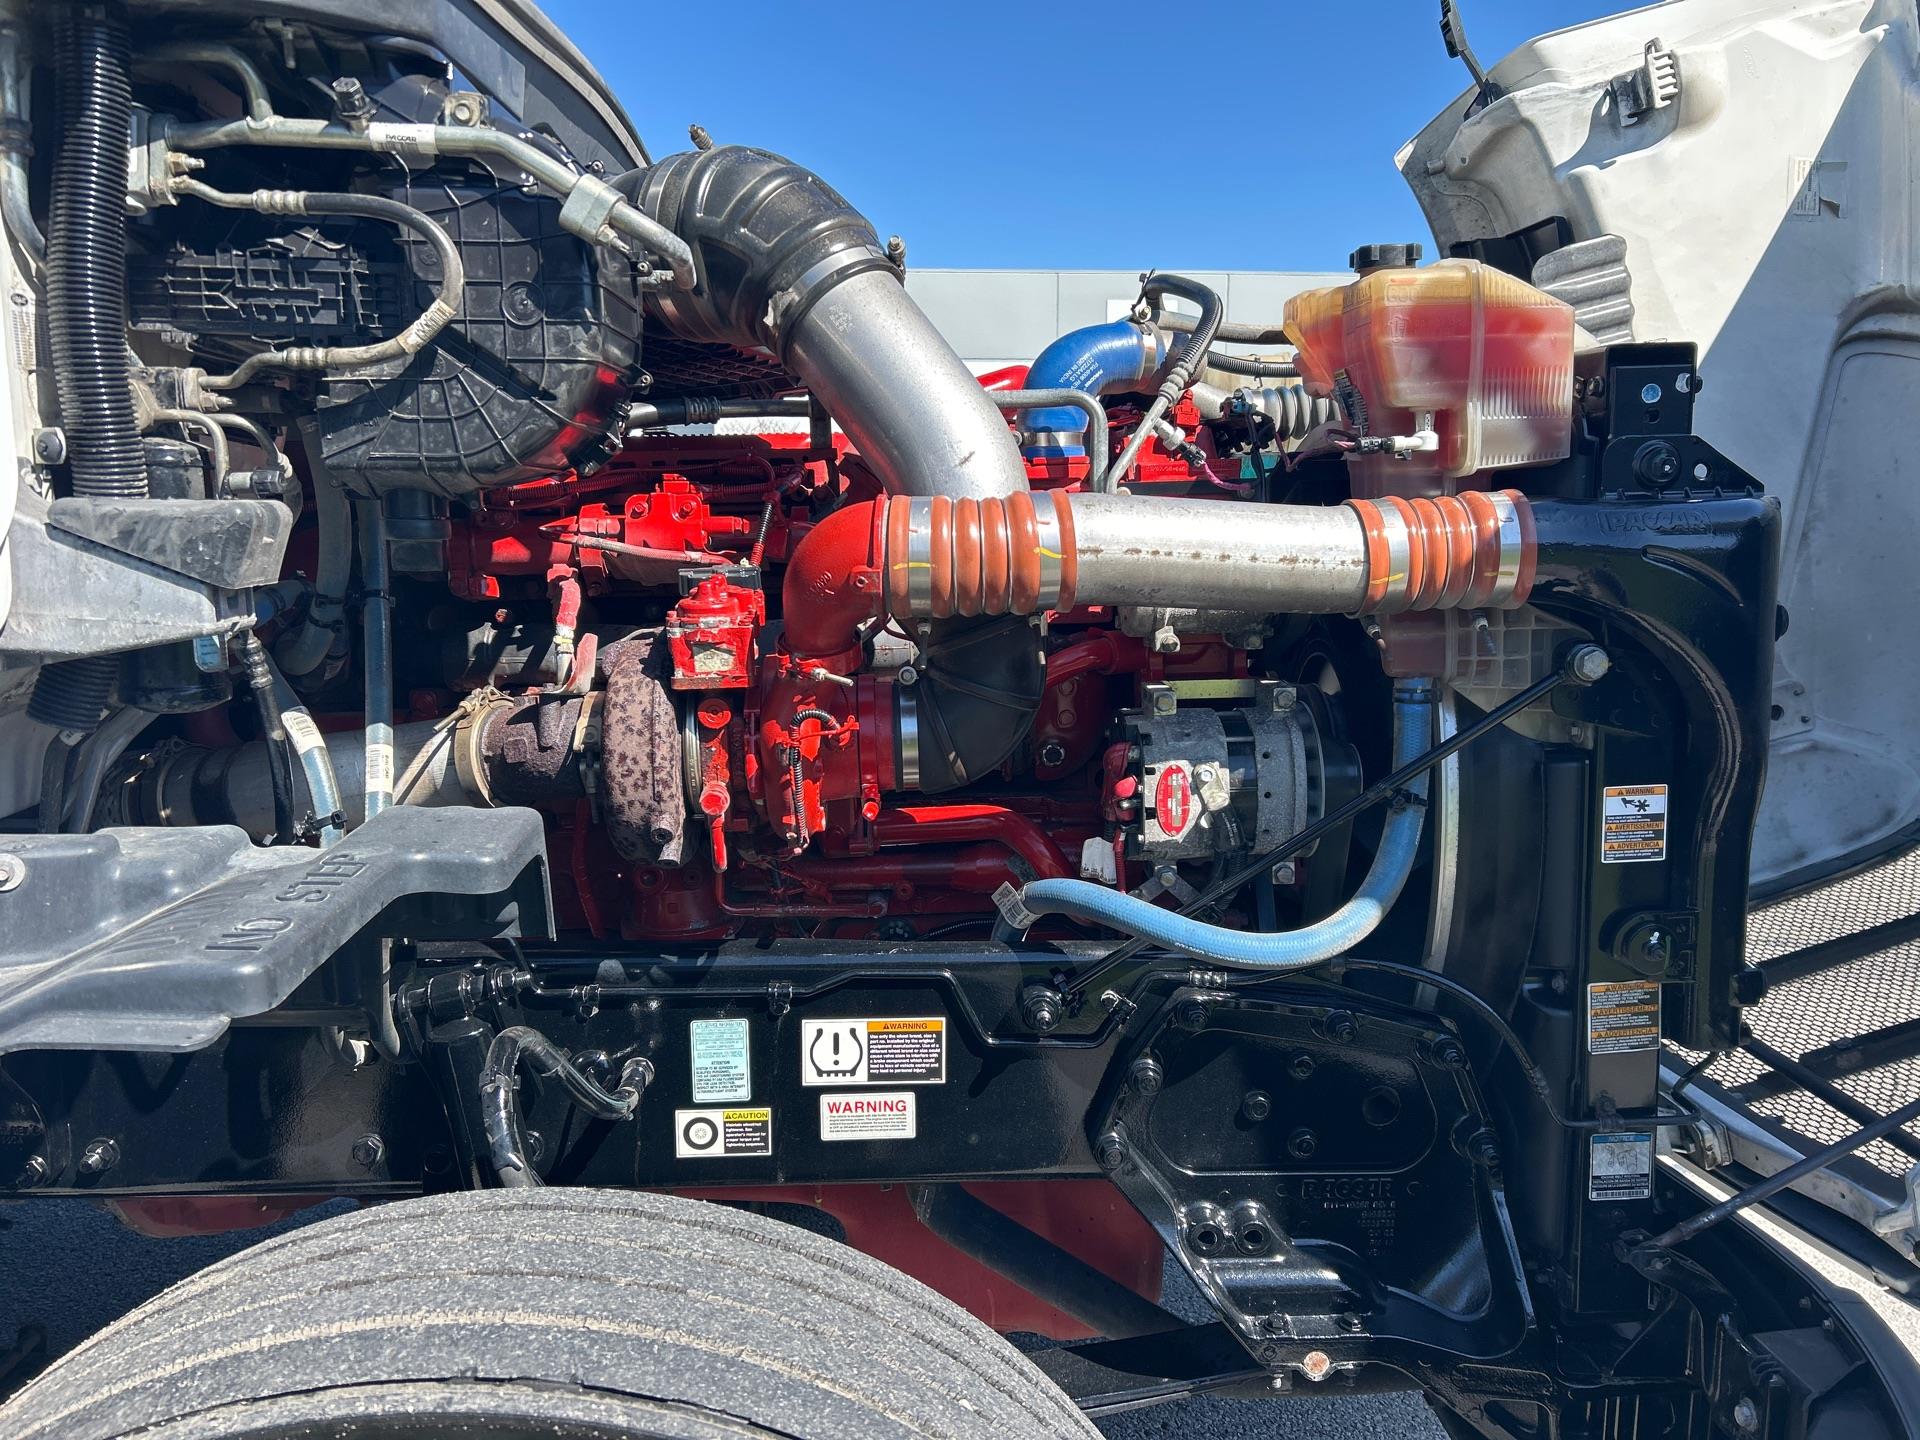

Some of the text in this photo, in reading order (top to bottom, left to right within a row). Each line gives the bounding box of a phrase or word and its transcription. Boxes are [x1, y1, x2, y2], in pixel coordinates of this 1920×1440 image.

[386, 133, 416, 142] PACCAR
[1604, 510, 1707, 532] PACCAR
[1615, 822, 1662, 830] AVERTISSEMENT
[204, 854, 370, 952] NO STEP
[828, 1100, 906, 1114] WARNING
